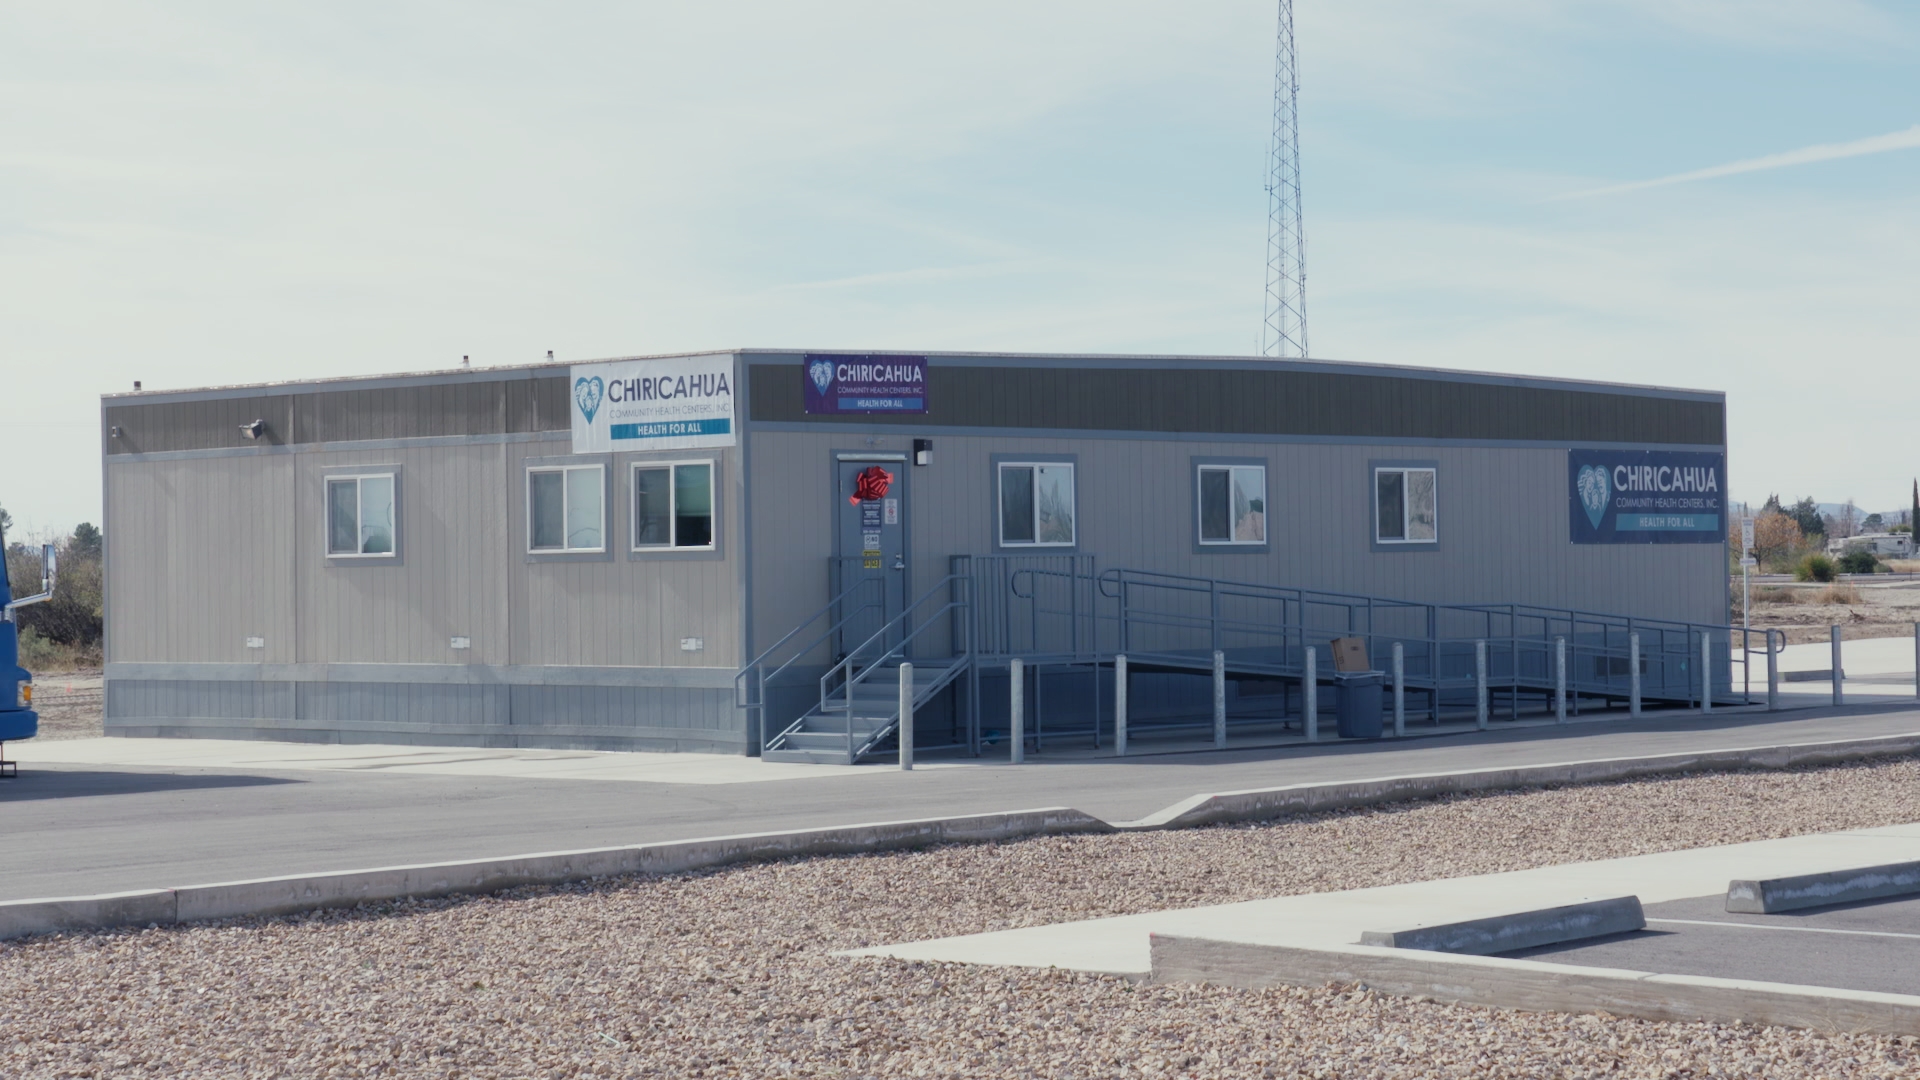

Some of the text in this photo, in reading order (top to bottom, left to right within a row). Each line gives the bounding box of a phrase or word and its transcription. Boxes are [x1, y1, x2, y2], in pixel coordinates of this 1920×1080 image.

[837, 364, 923, 382] CHIRICAHUA
[608, 372, 731, 403] CHIRICAHUA
[837, 386, 869, 394] COMMUNITY
[870, 386, 888, 394] HEALTH
[857, 399, 903, 408] HEALTH FOR ALL
[609, 407, 654, 419] COMMUNITY
[655, 406, 680, 416] HEALTH
[637, 422, 702, 436] HEALTH FOR ALL
[1613, 464, 1718, 493] CHIRICAHUA
[1615, 497, 1653, 508] COMMUNITY
[1655, 498, 1677, 508] HEALTH
[1706, 498, 1720, 509] INC.
[1640, 517, 1695, 528] HEALTH FOR ALL
